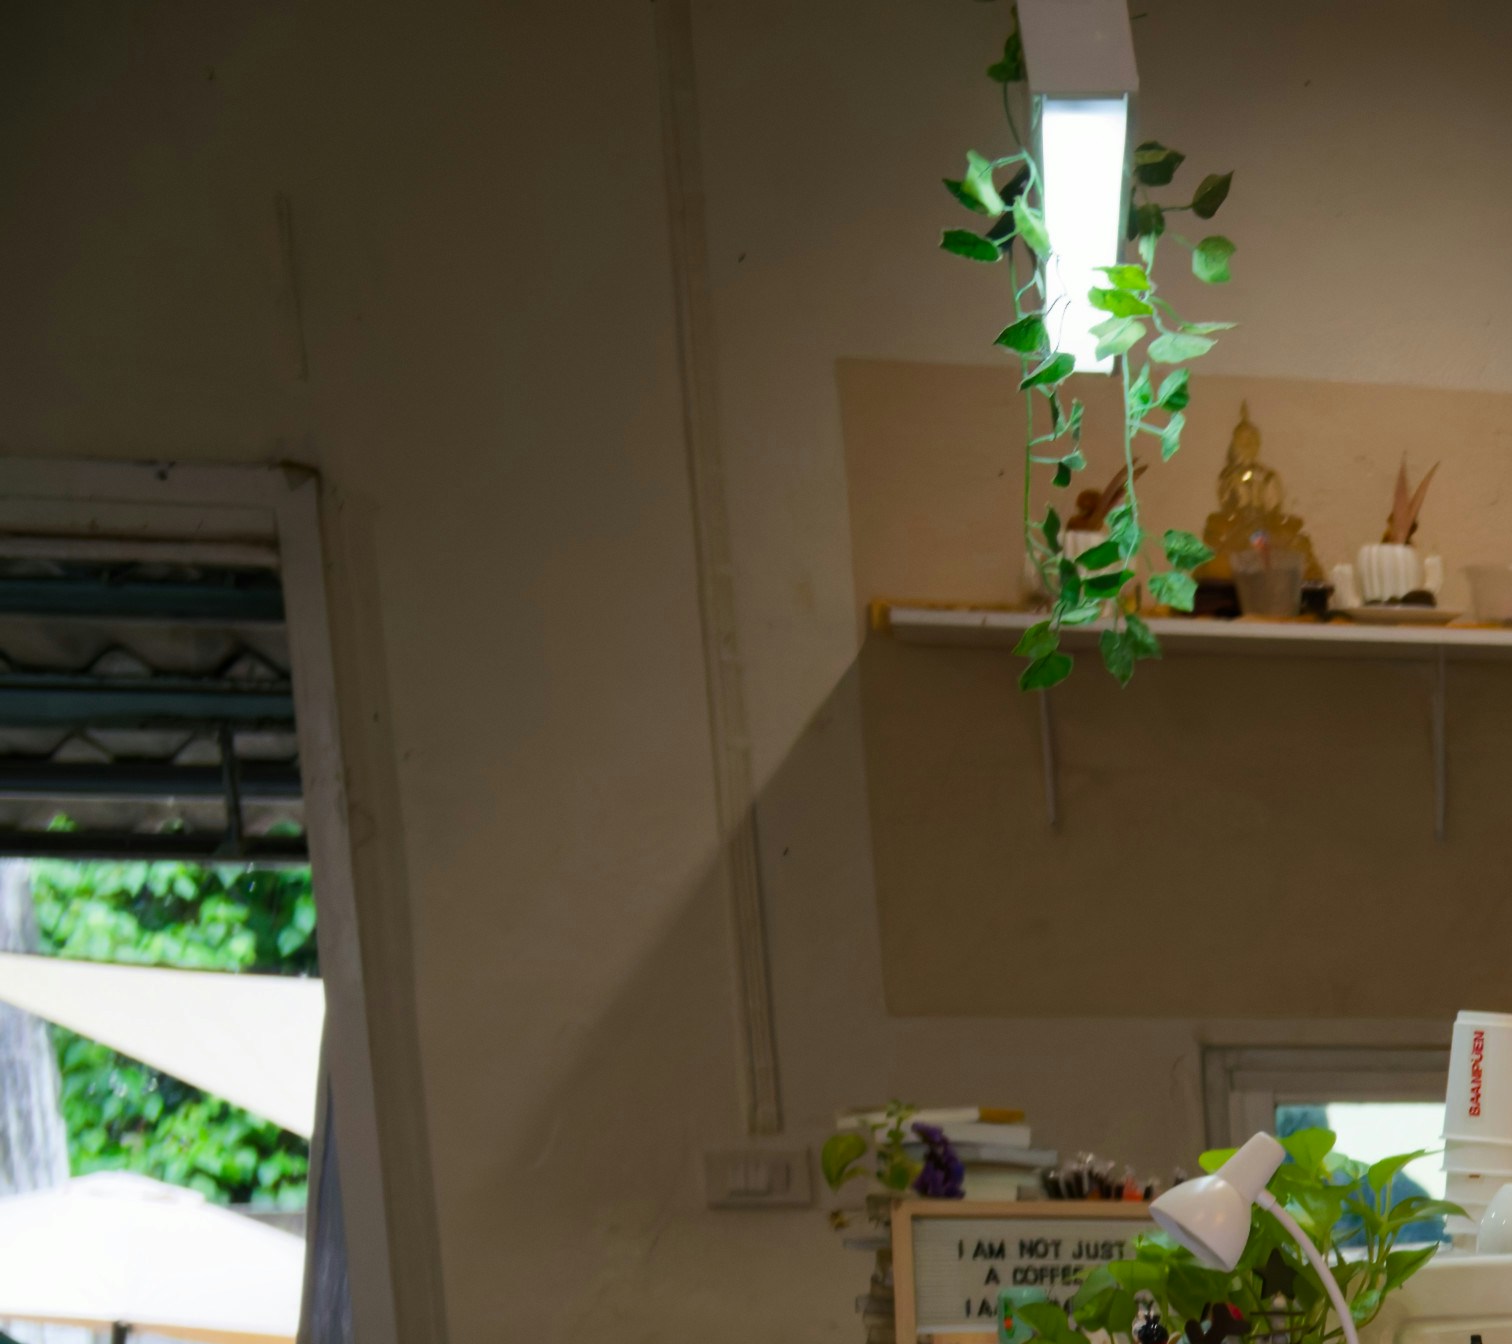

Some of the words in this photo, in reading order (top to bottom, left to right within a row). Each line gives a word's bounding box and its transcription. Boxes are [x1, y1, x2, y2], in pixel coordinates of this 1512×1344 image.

[958, 1239, 963, 1259] I
[972, 1240, 1005, 1259] AM
[1019, 1239, 1061, 1259] NOT
[1072, 1241, 1125, 1260] JUST
[985, 1267, 1000, 1285] A
